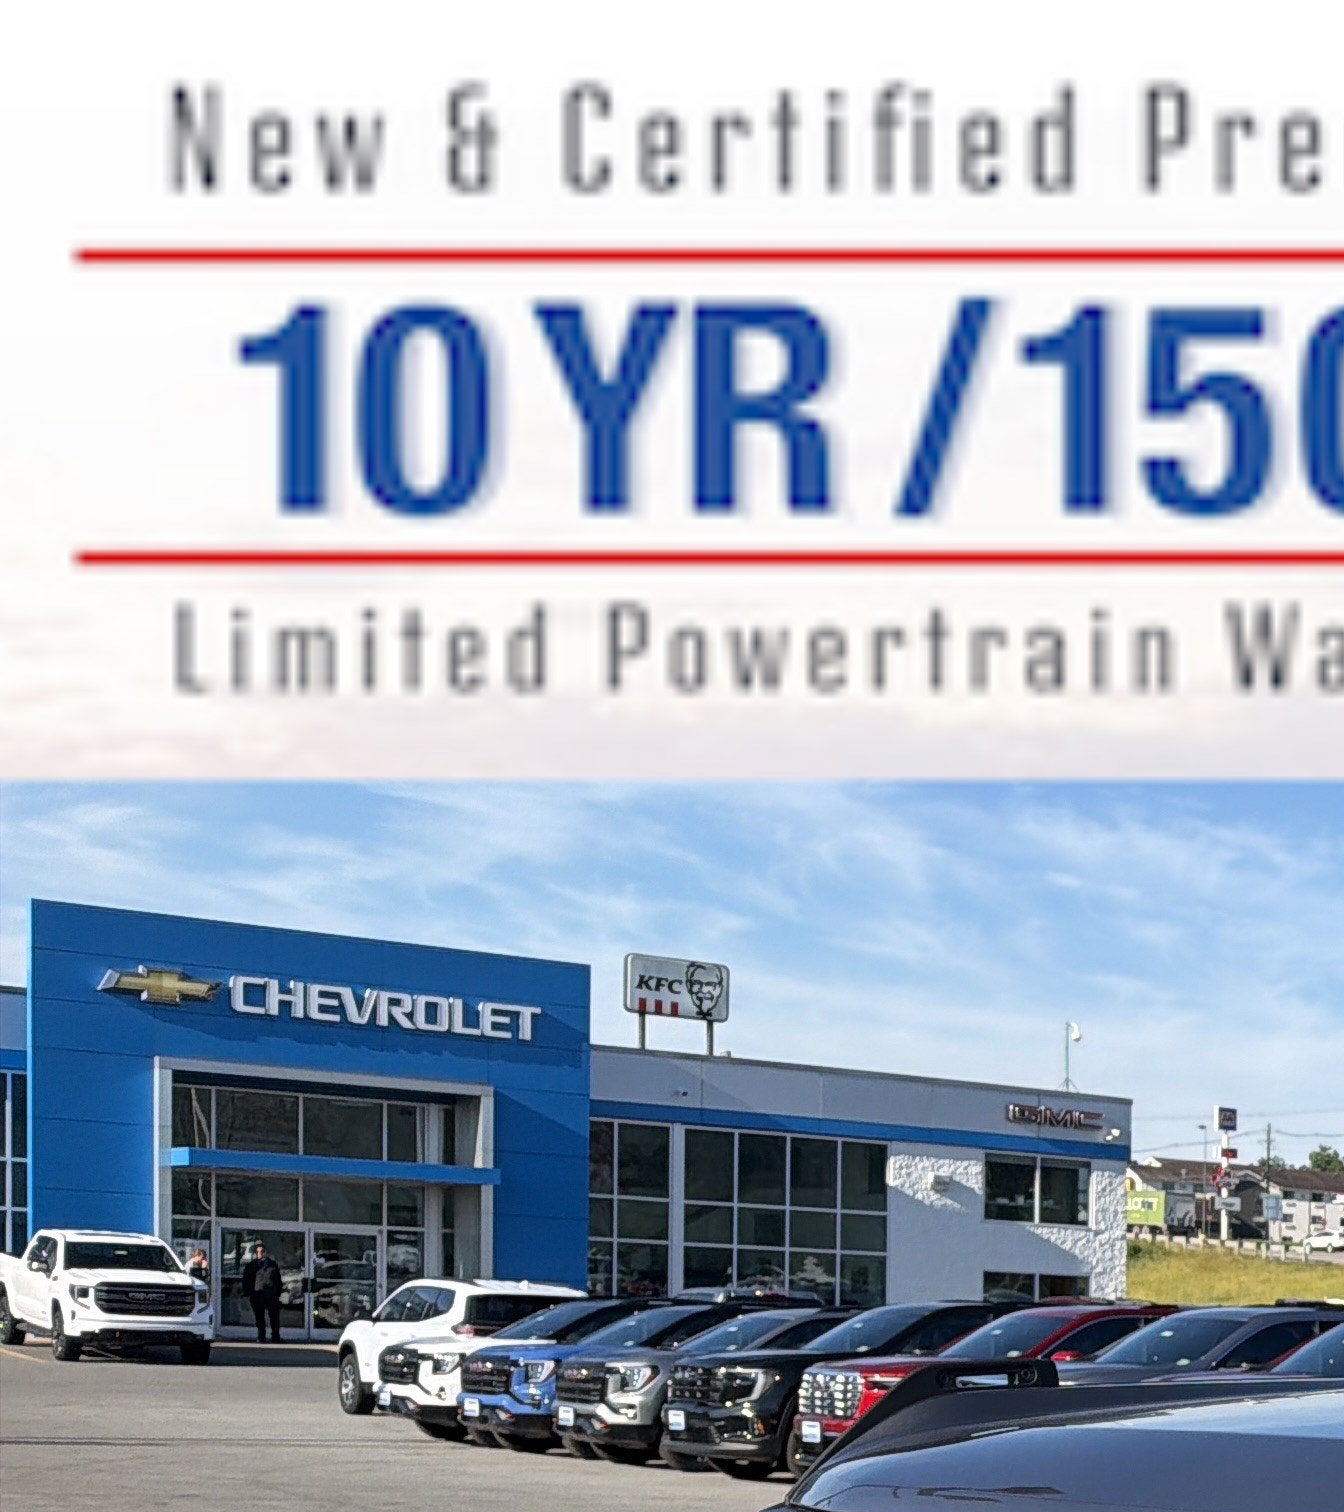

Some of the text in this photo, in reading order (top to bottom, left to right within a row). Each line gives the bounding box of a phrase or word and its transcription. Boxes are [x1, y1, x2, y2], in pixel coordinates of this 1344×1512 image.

[635, 973, 684, 995] KFC
[229, 975, 542, 1042] CHEVROLET
[1006, 1103, 1106, 1130] GMC
